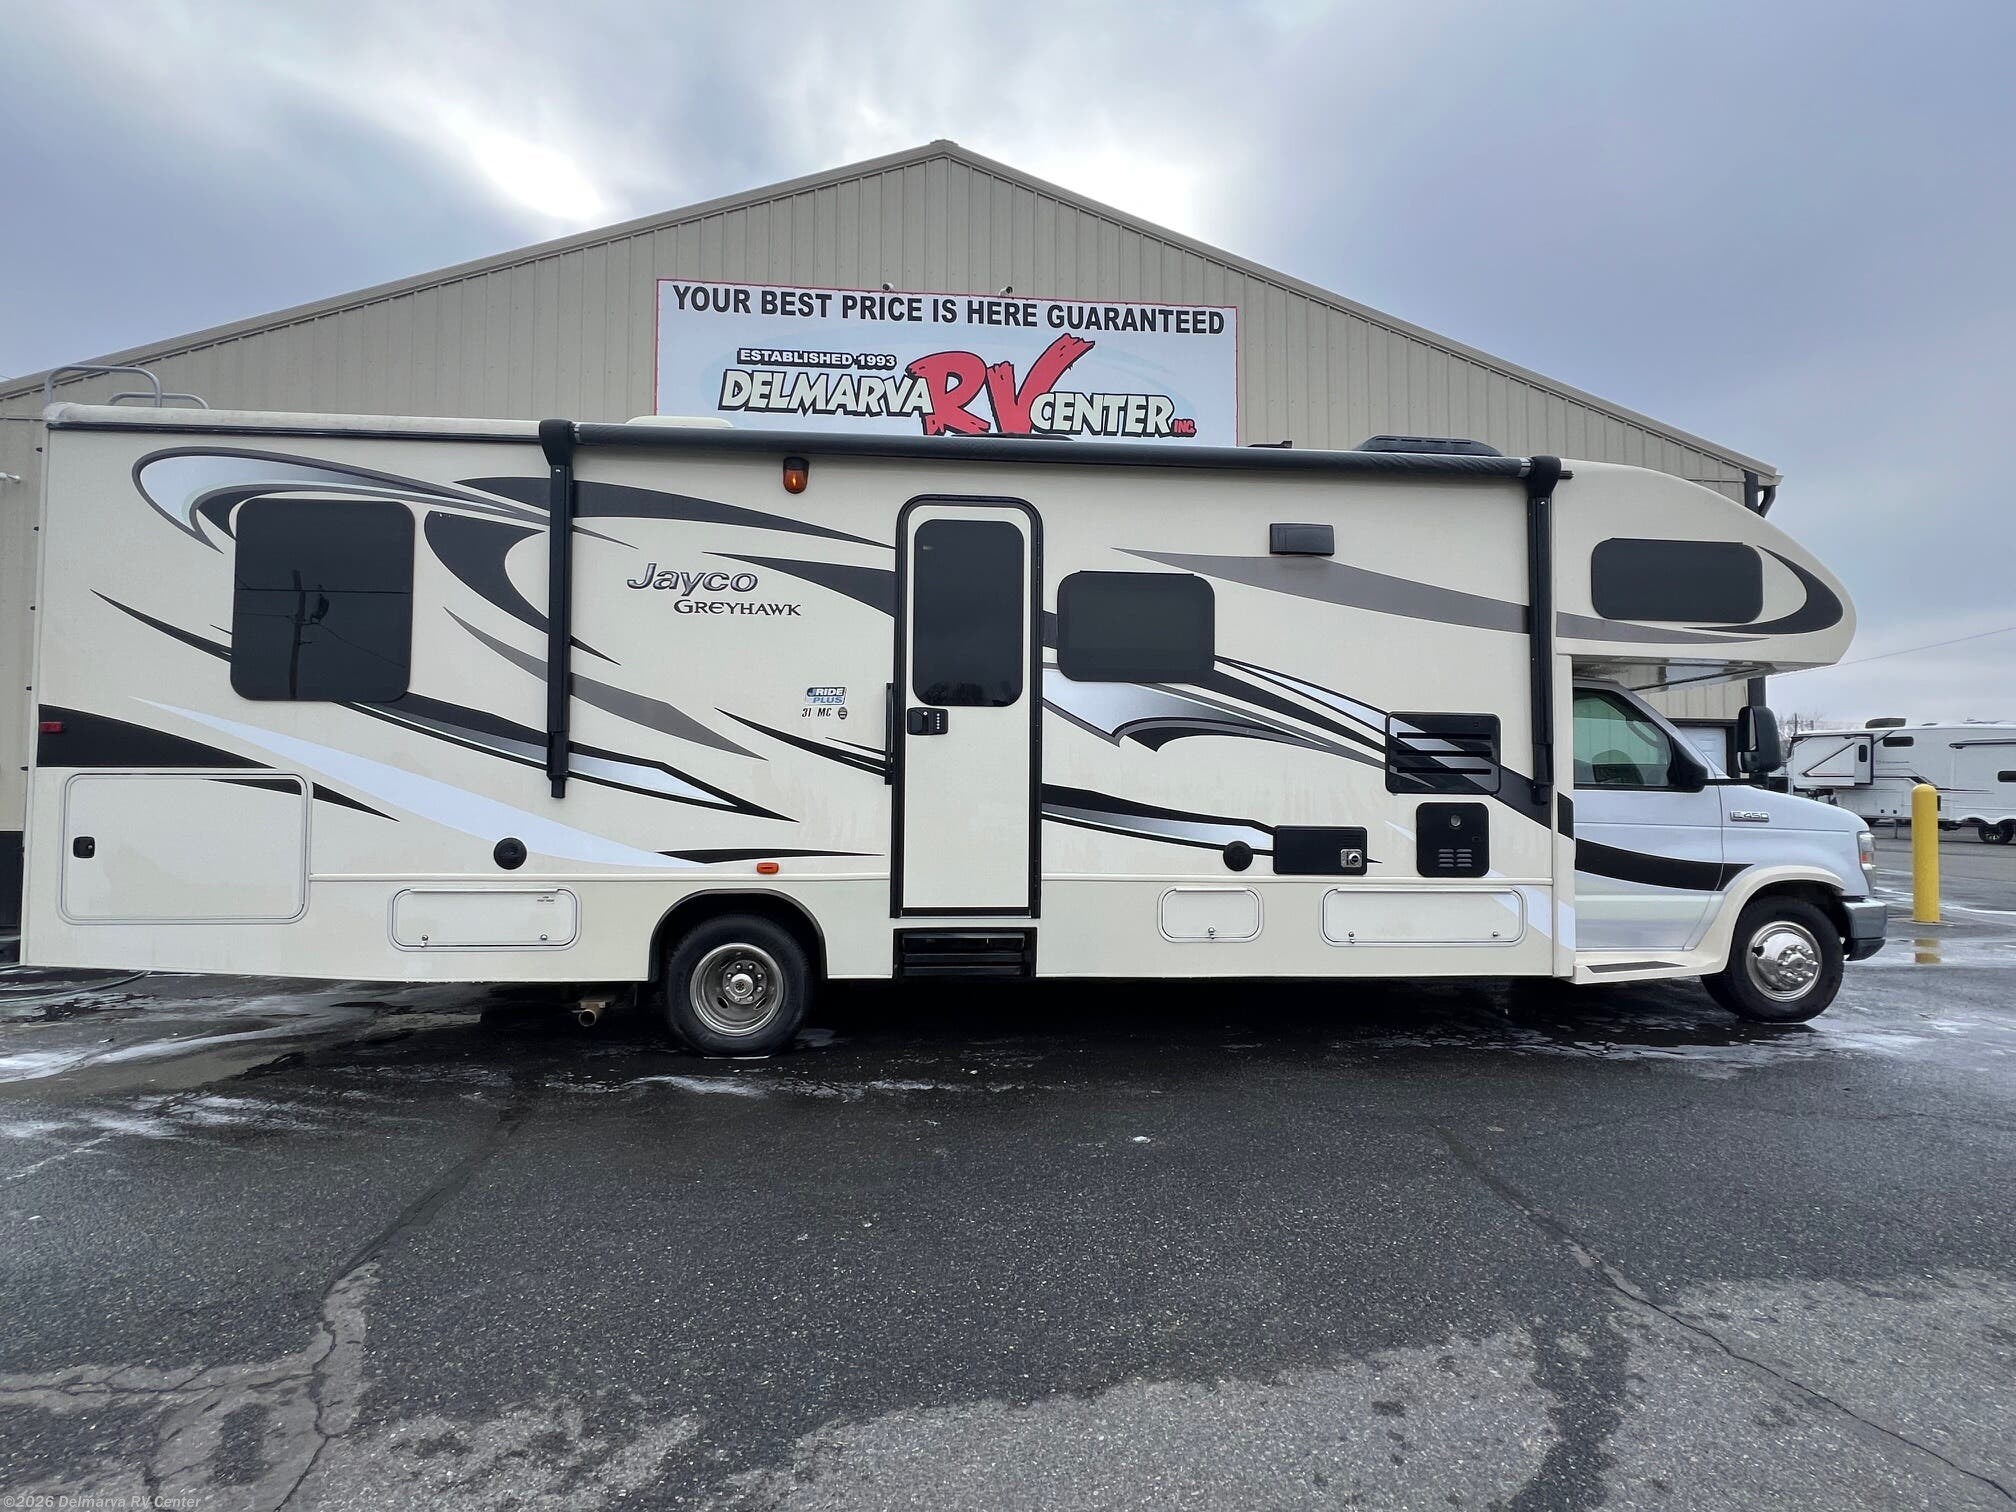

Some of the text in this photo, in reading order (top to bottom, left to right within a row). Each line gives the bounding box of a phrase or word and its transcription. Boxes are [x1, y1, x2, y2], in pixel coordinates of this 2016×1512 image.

[673, 285, 1225, 334] YOUR BEST PRICE IS HERE GUARANTEED
[740, 349, 896, 367] ESTABLISHED 1993
[718, 332, 1197, 437] DELMARVA RV CENTER INC.
[626, 562, 759, 597] Jayco
[673, 598, 802, 617] GREYHAWK
[812, 696, 843, 704] PLUS
[801, 707, 832, 718] 31 MC
